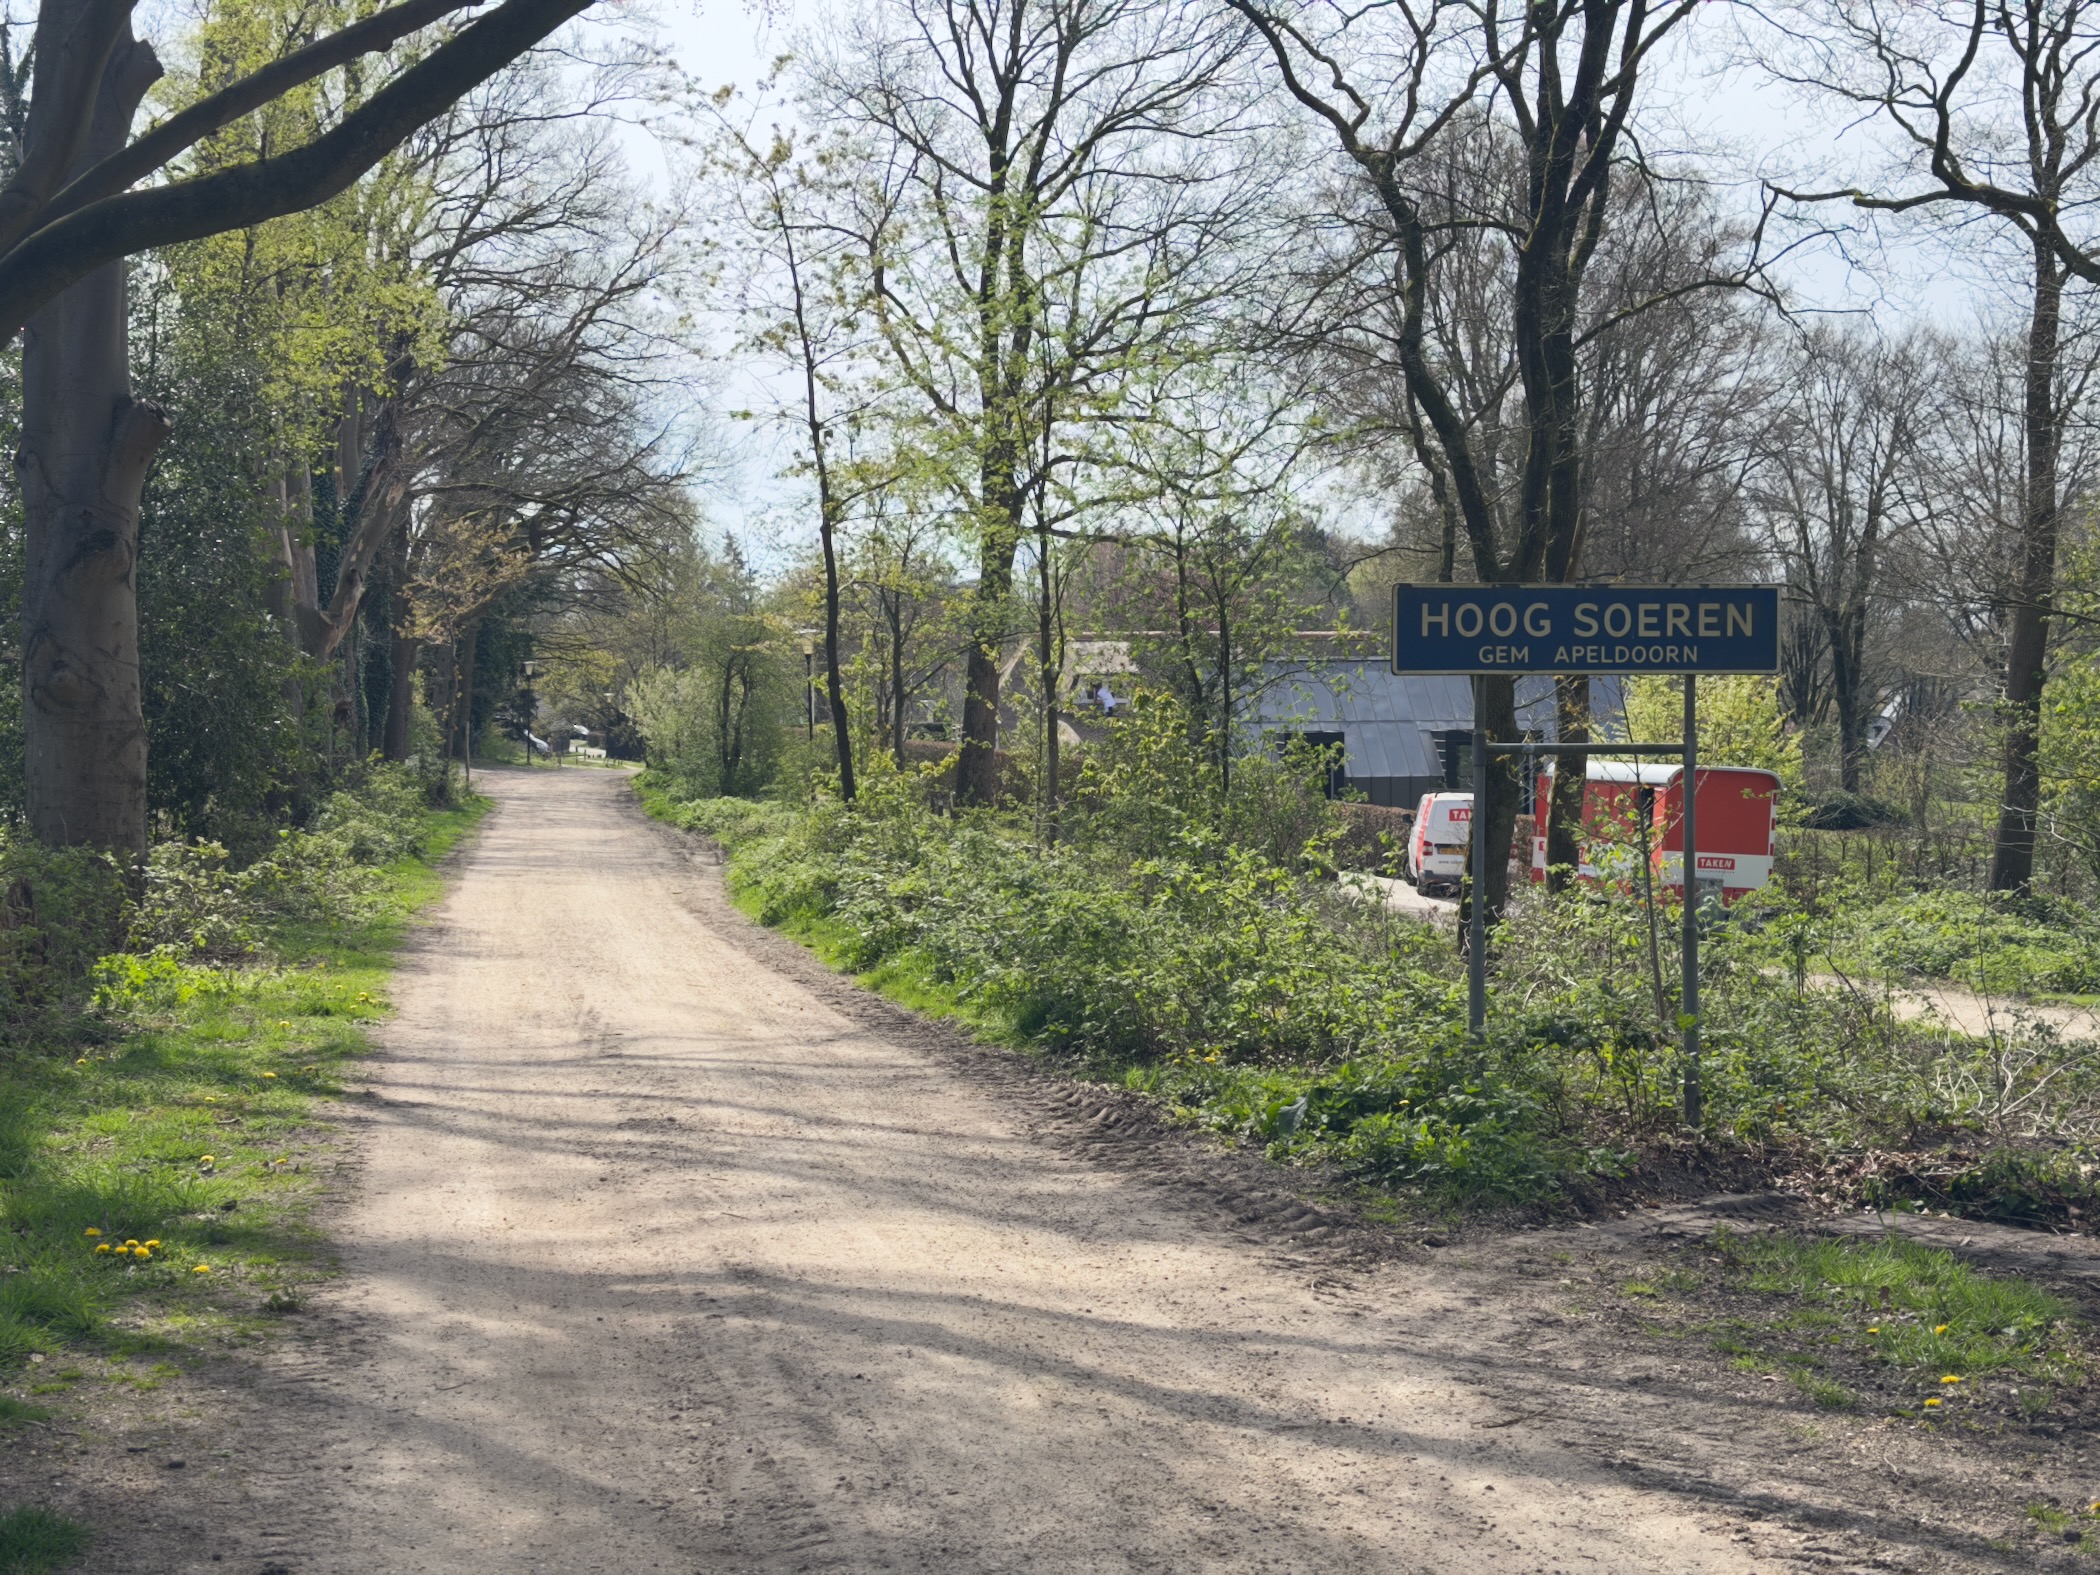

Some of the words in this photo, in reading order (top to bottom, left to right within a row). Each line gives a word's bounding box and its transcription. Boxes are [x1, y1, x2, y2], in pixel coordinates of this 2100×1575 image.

[1421, 602, 1552, 638] HOOG
[1573, 602, 1753, 638] SOEREN
[1478, 645, 1529, 664] GEM
[1553, 645, 1698, 664] APELDOORN
[1700, 858, 1733, 869] TAKEN
